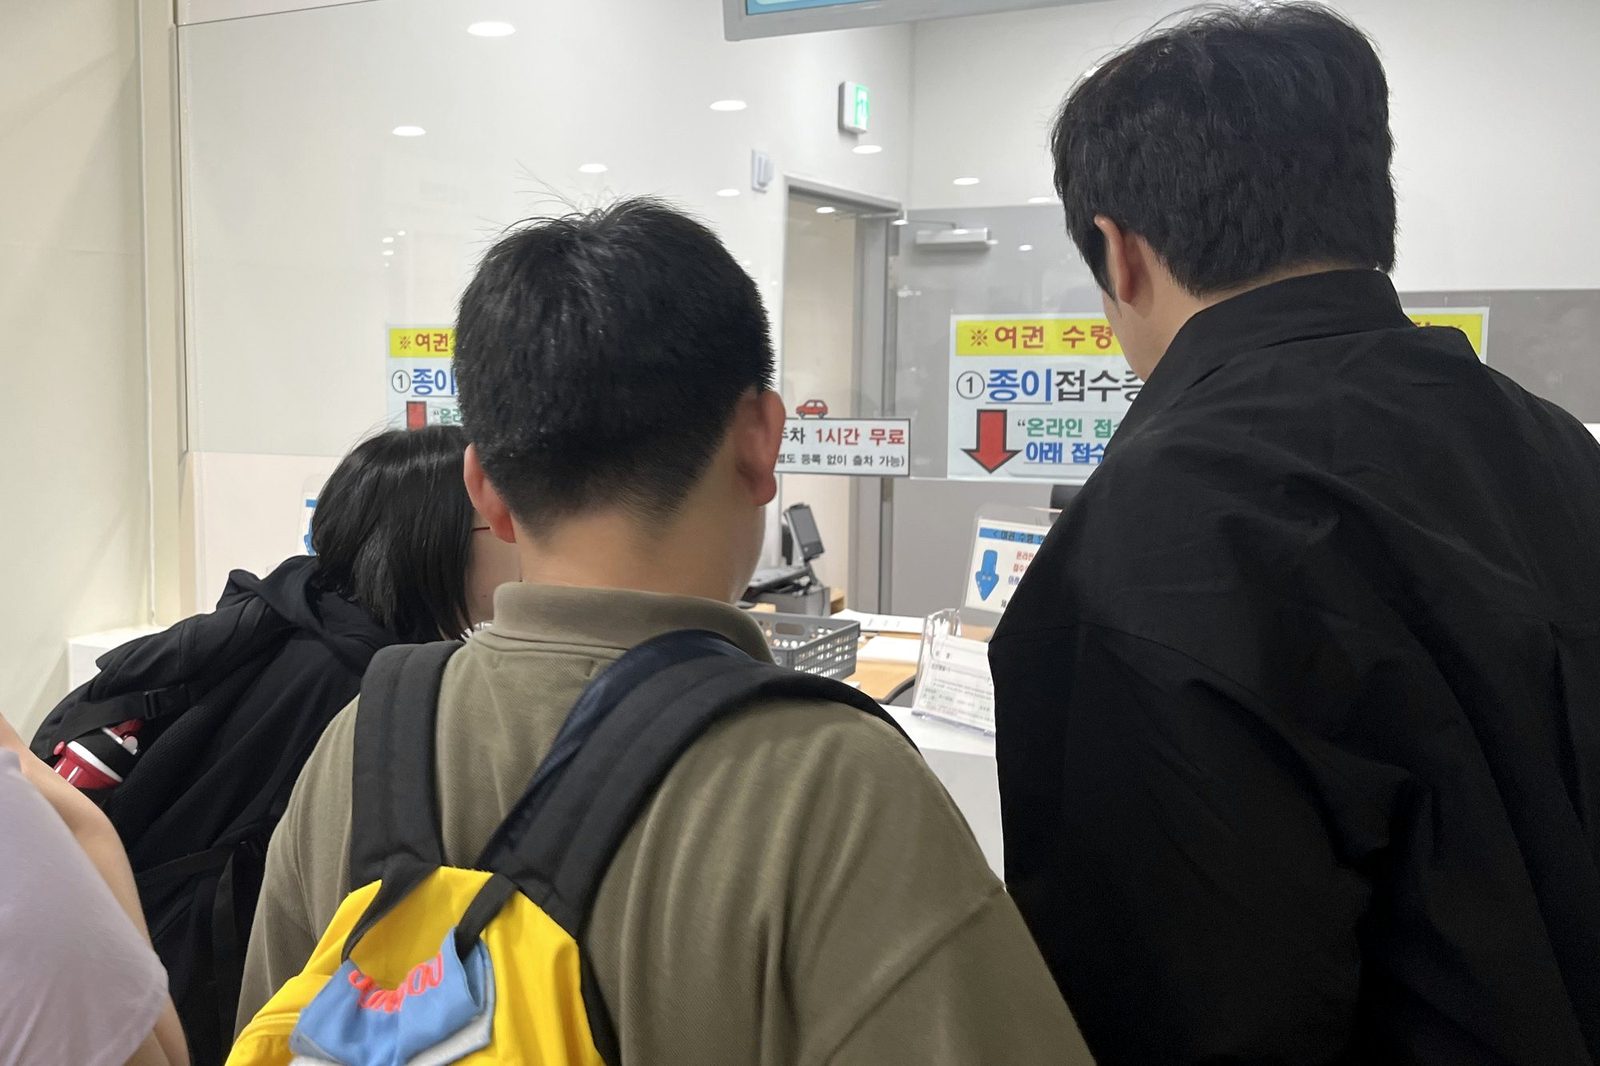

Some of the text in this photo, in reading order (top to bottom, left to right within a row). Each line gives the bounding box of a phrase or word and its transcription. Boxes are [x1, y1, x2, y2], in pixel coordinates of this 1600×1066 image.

[1062, 325, 1113, 349] 수령
[816, 427, 860, 445] 1시간
[869, 429, 905, 446] 무료
[1094, 418, 1120, 438] 접
[827, 454, 847, 466] 없이
[1026, 442, 1063, 464] 아래
